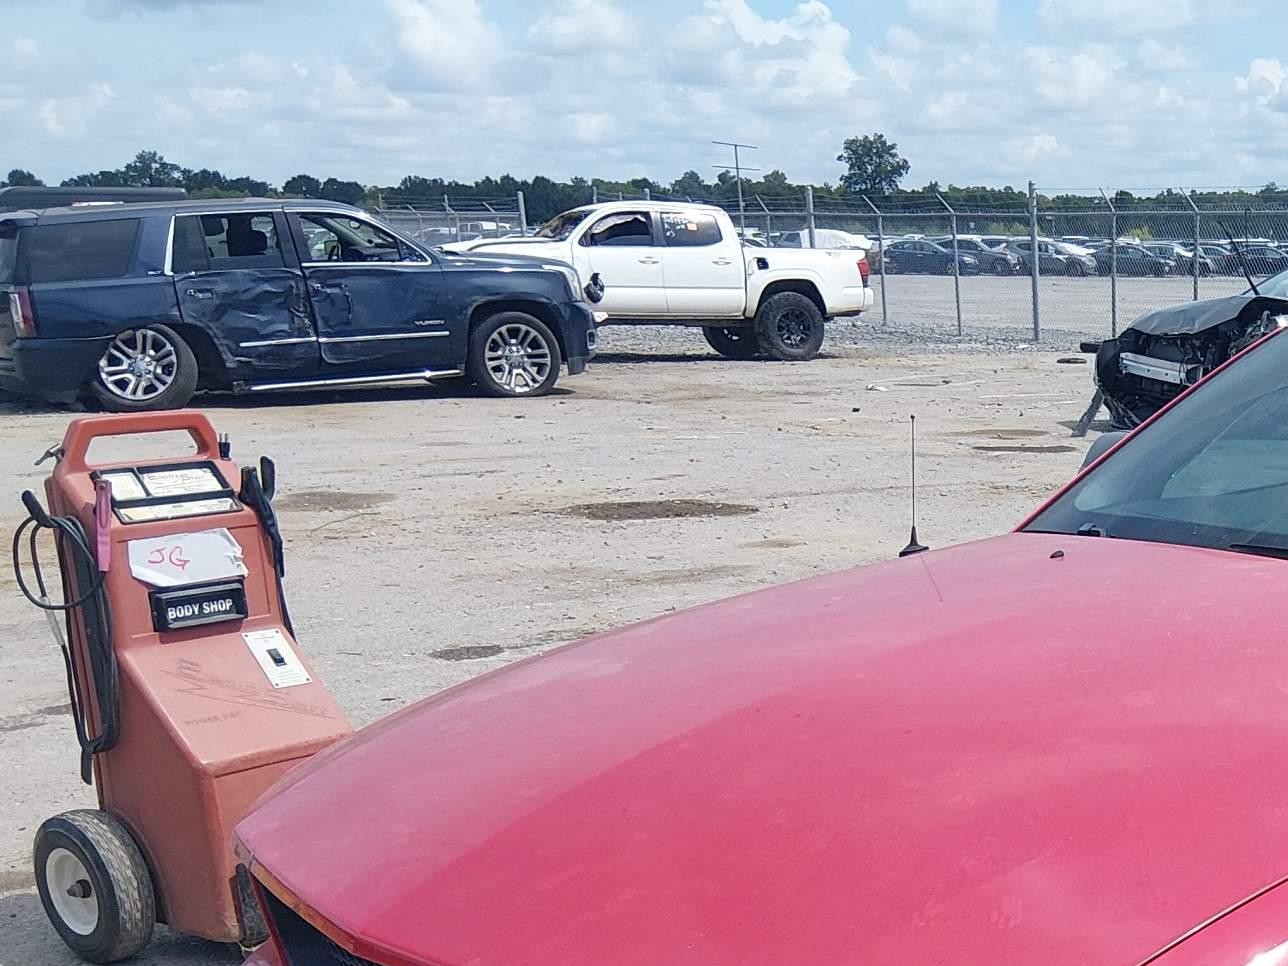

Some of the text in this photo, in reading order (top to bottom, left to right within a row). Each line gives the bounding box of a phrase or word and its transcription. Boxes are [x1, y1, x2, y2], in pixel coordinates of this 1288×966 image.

[148, 546, 190, 570] JG
[167, 599, 233, 619] BODY SHOP
